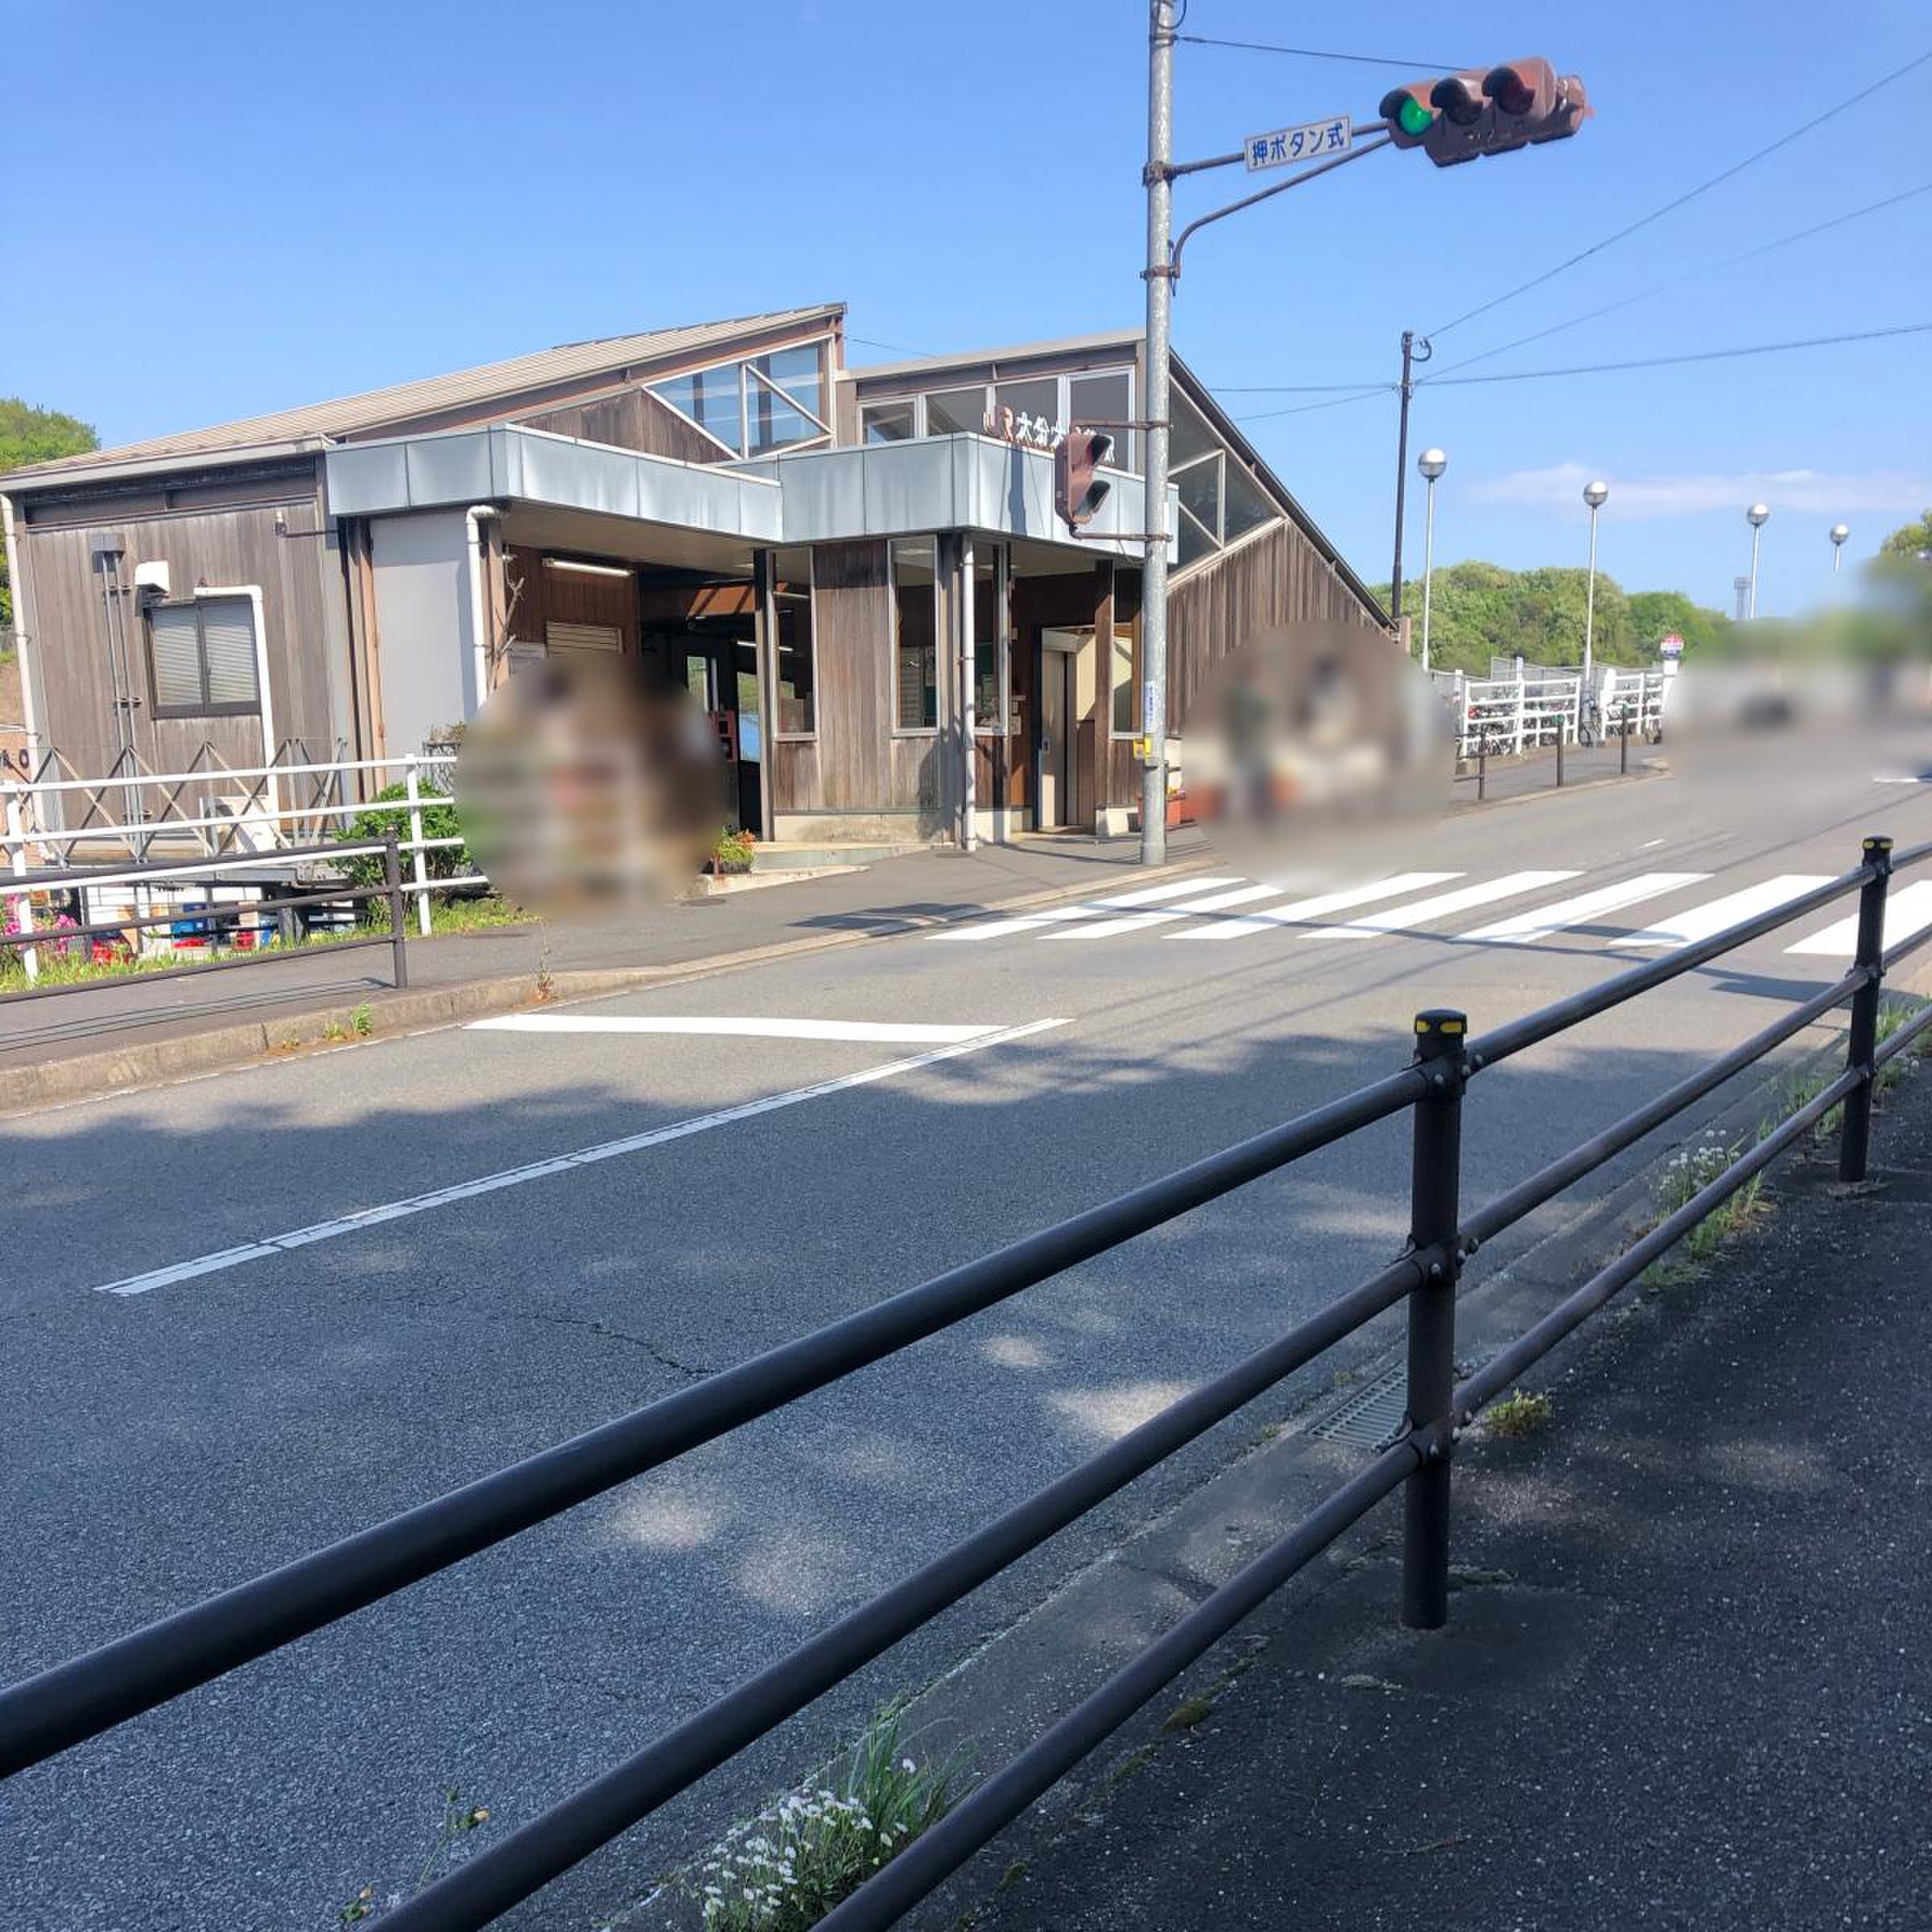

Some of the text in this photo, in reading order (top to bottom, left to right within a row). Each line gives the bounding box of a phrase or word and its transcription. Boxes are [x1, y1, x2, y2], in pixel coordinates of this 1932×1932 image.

[1253, 122, 1344, 166] 押ボタン式
